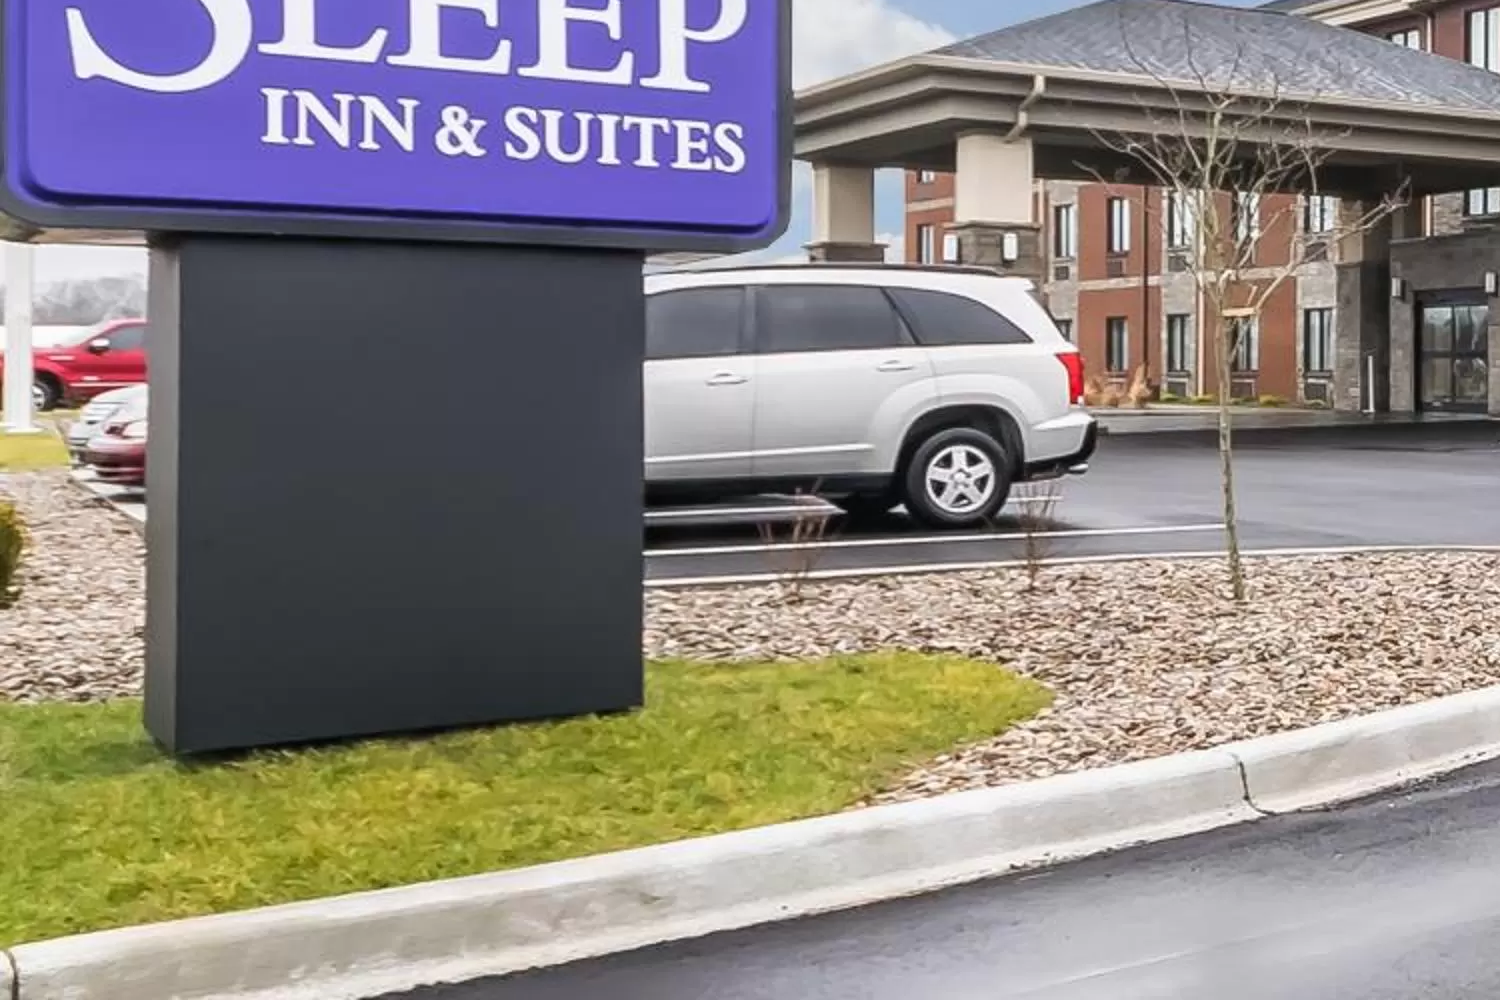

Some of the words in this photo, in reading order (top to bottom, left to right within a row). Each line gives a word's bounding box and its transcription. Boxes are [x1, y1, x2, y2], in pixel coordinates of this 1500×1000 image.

[260, 87, 419, 153] INN
[435, 106, 486, 157] &
[504, 107, 746, 173] SUITES
